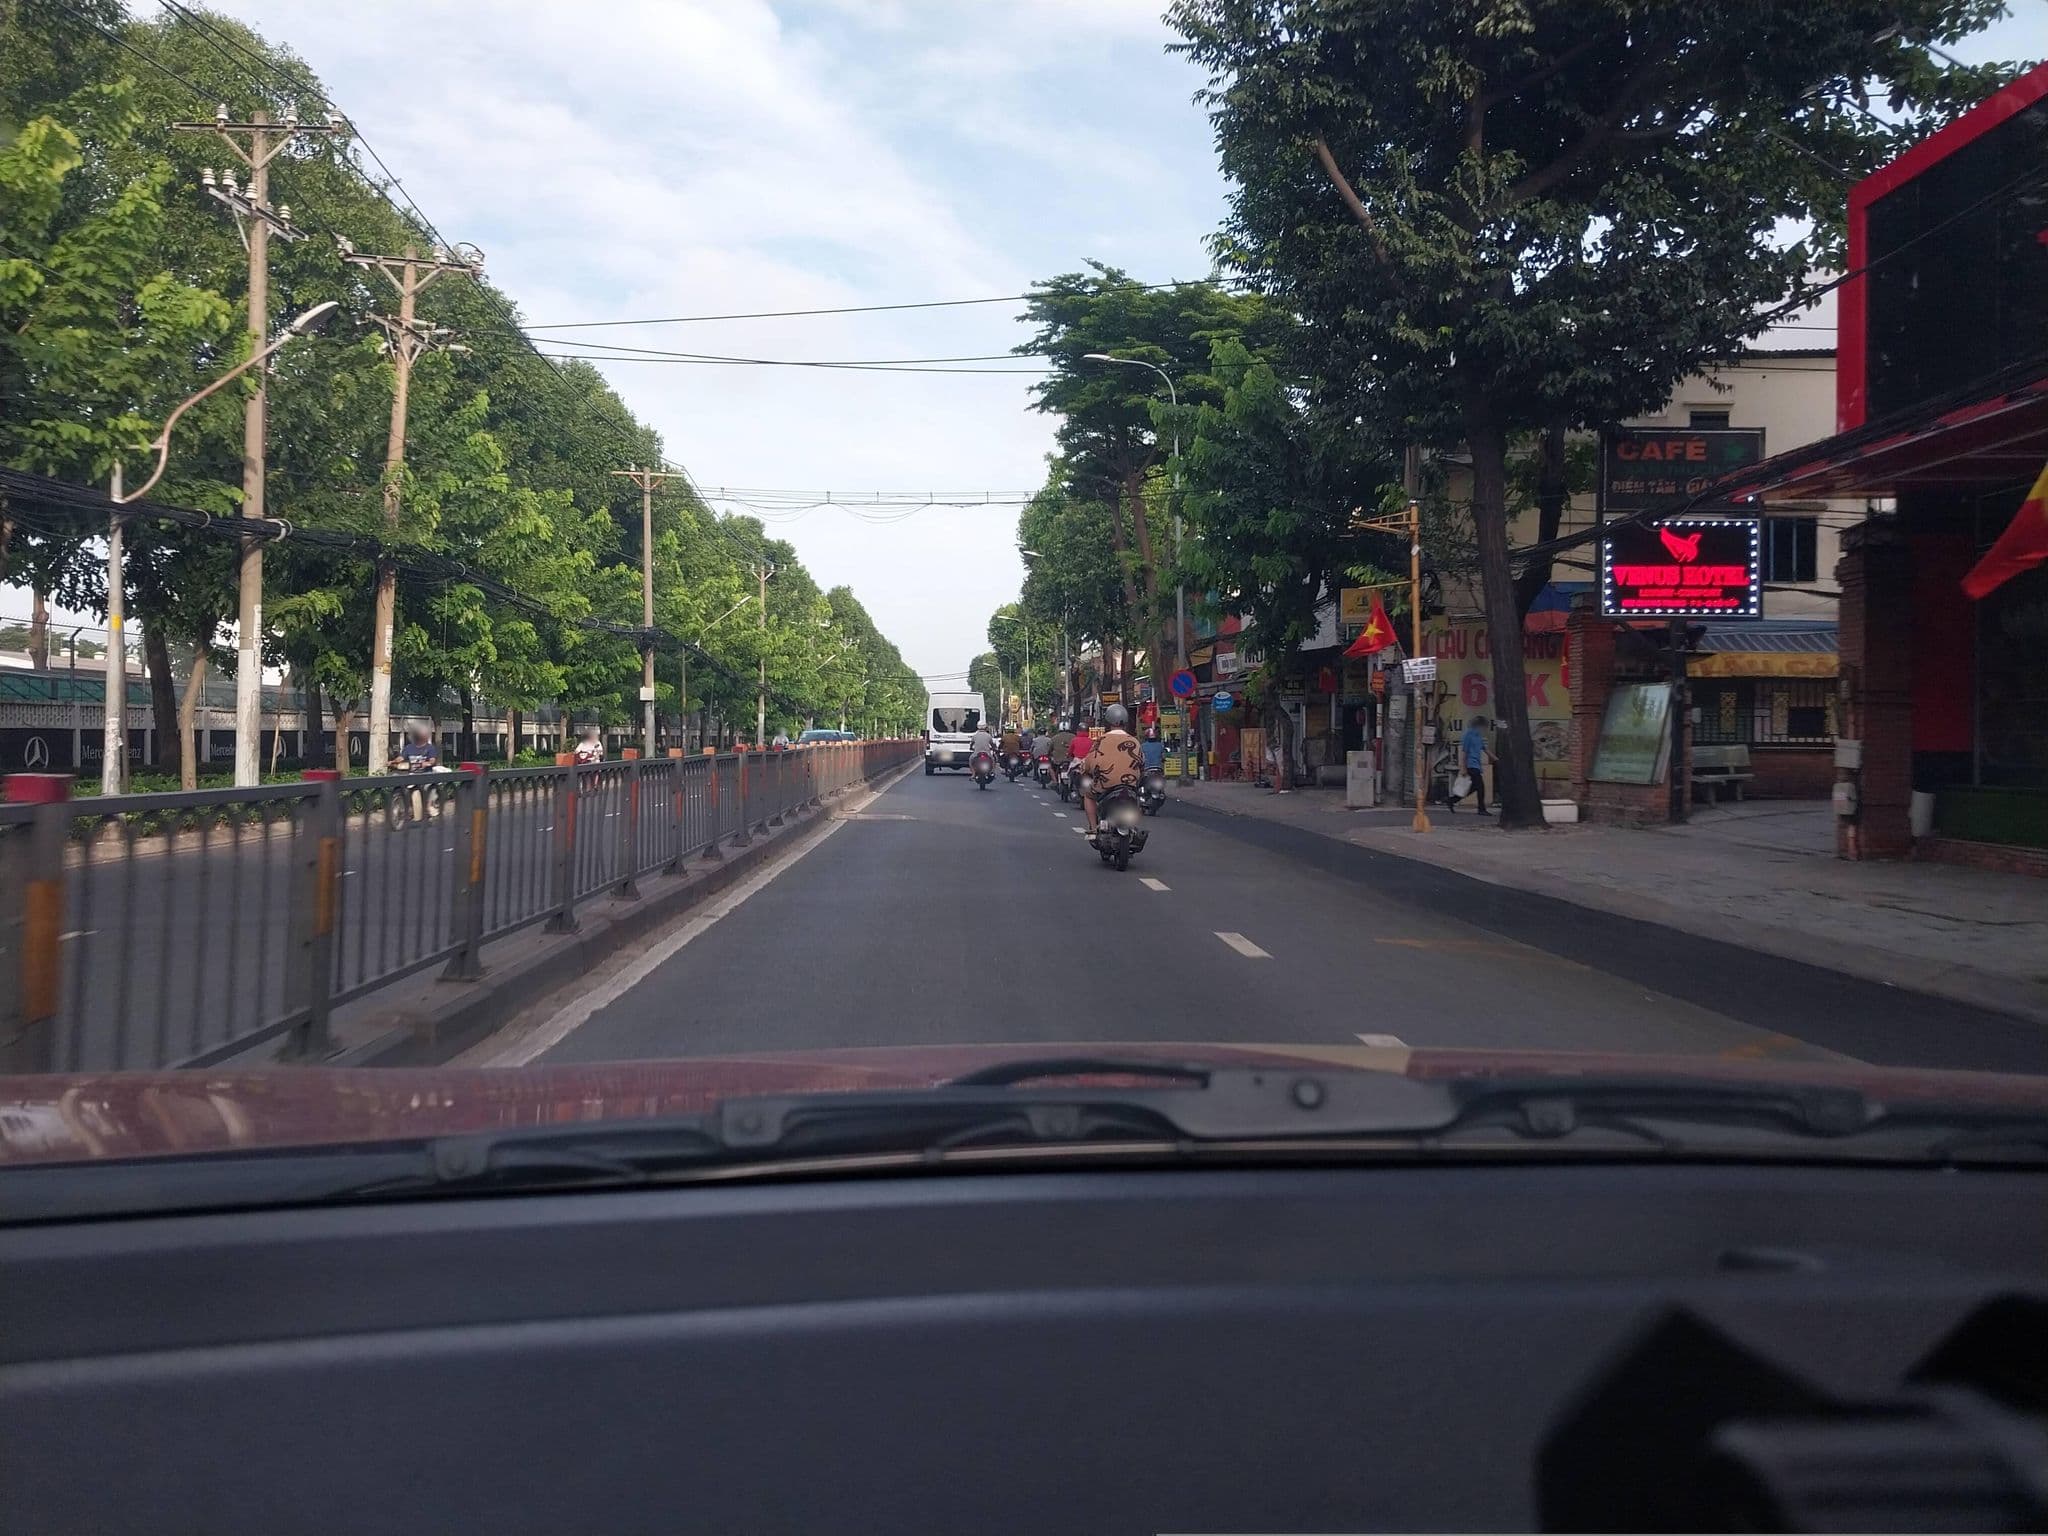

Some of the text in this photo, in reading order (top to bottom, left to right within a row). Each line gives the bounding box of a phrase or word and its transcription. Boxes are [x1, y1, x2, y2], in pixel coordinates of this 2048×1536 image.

[1617, 437, 1708, 461] CAFÉ
[1612, 566, 1750, 586] VENUS HOTEL
